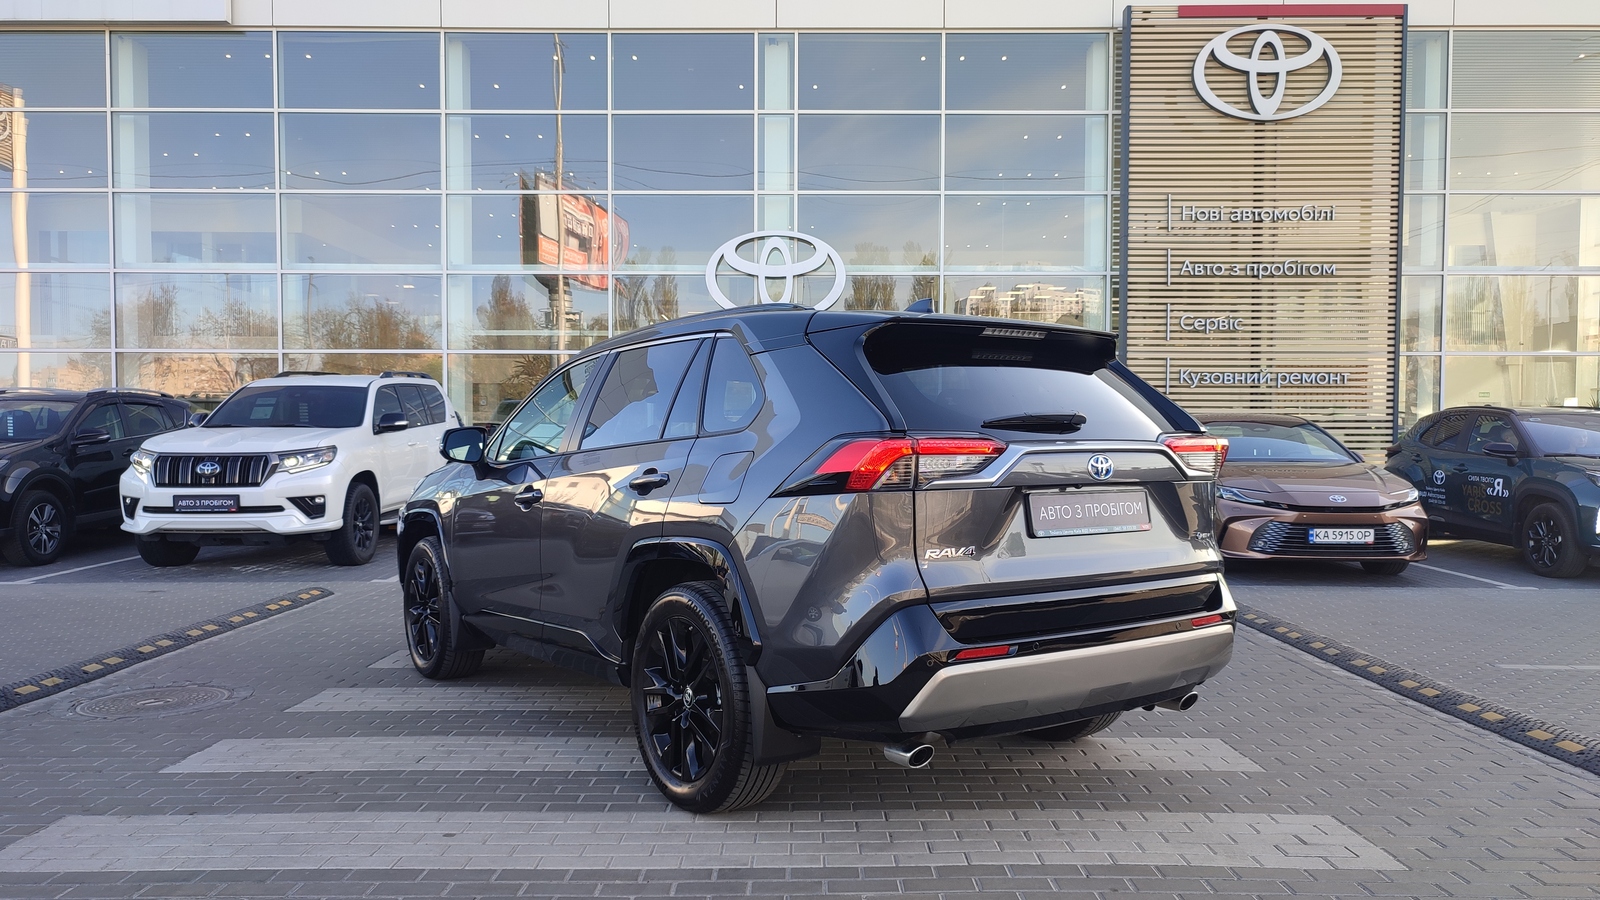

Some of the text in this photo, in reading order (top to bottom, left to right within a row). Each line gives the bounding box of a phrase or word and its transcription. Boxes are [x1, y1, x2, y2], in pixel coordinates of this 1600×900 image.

[1181, 204, 1336, 221] Нові автомобілі
[1179, 259, 1337, 280] Авто з пробігом
[1179, 314, 1245, 334] Сервіс
[1179, 368, 1351, 388] Кузовний ремонт
[1462, 484, 1486, 498] YARIS
[1039, 501, 1143, 521] АВТО З ПРОБІГОМ
[1468, 498, 1502, 515] CROSS
[1332, 530, 1355, 540] 5915
[924, 545, 976, 560] RAV4
